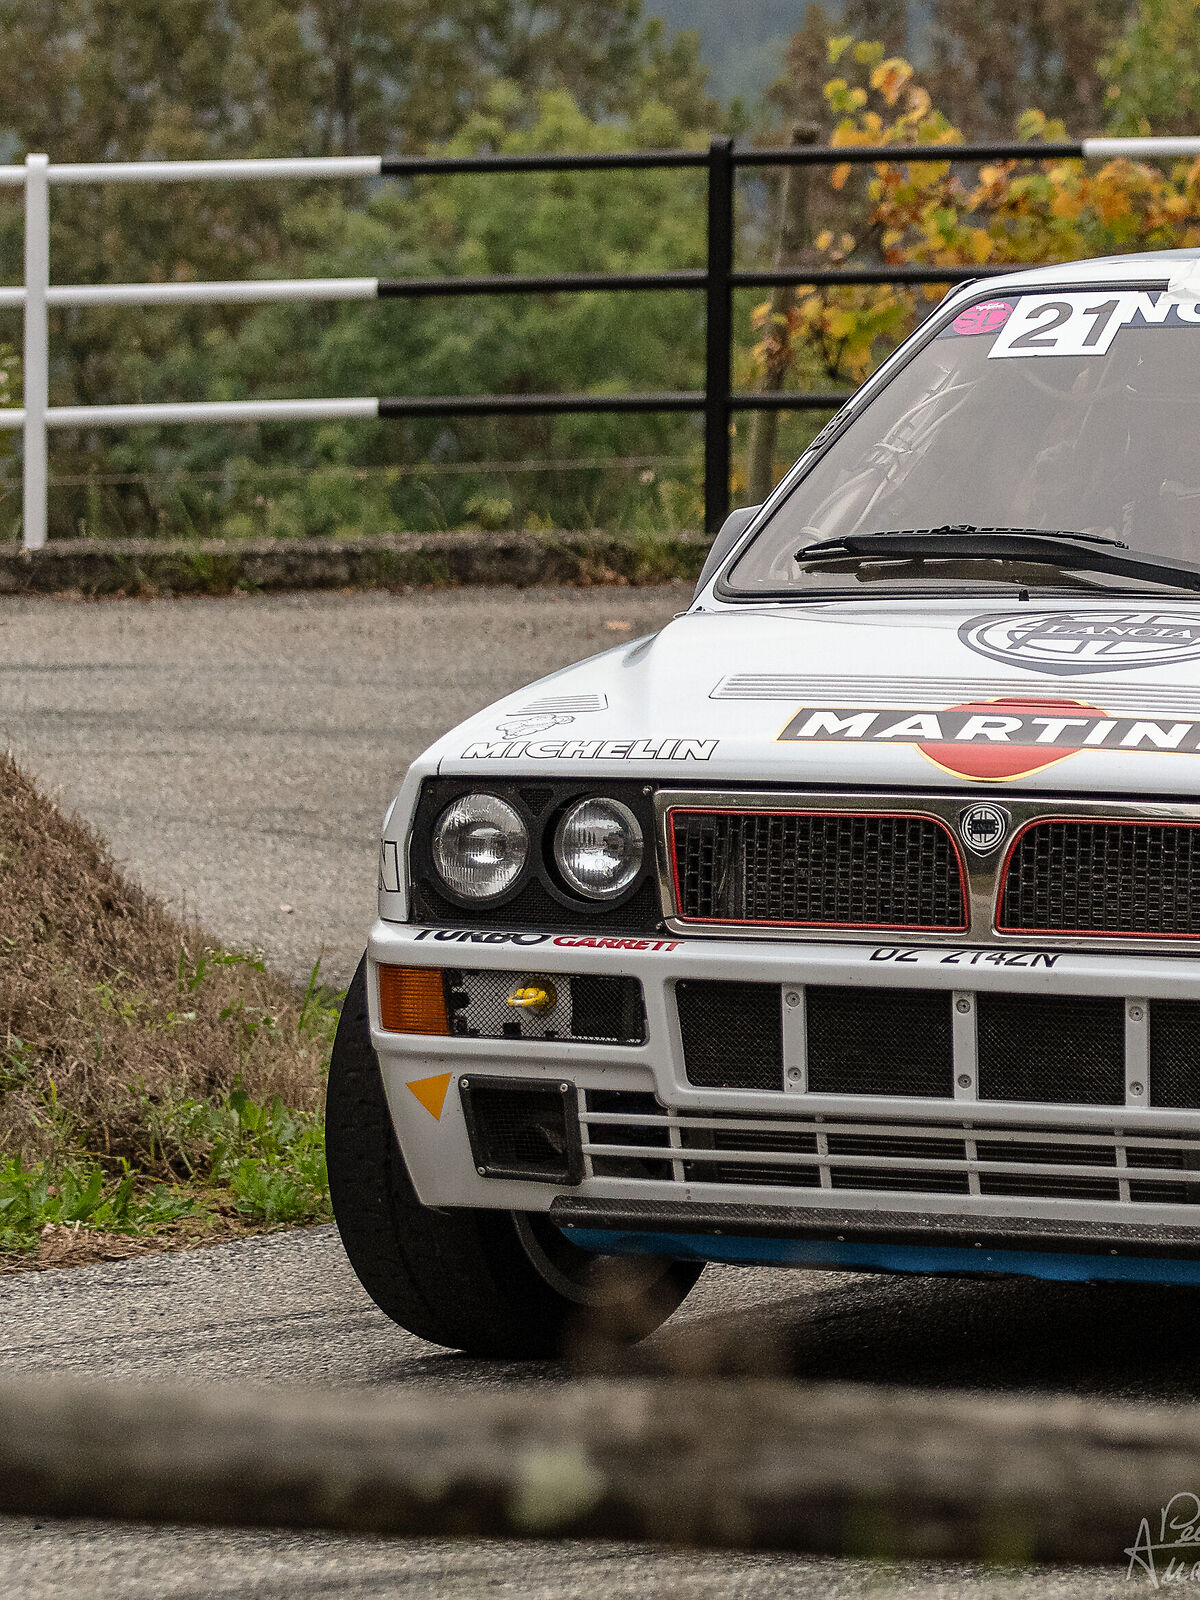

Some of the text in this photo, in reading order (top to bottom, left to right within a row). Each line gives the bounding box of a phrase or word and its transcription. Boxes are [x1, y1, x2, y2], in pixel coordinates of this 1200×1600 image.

[1008, 300, 1120, 348] 21
[1044, 625, 1194, 639] LANCIA
[461, 739, 720, 760] MICHELIN
[414, 929, 685, 951] TURBO GARRETT
